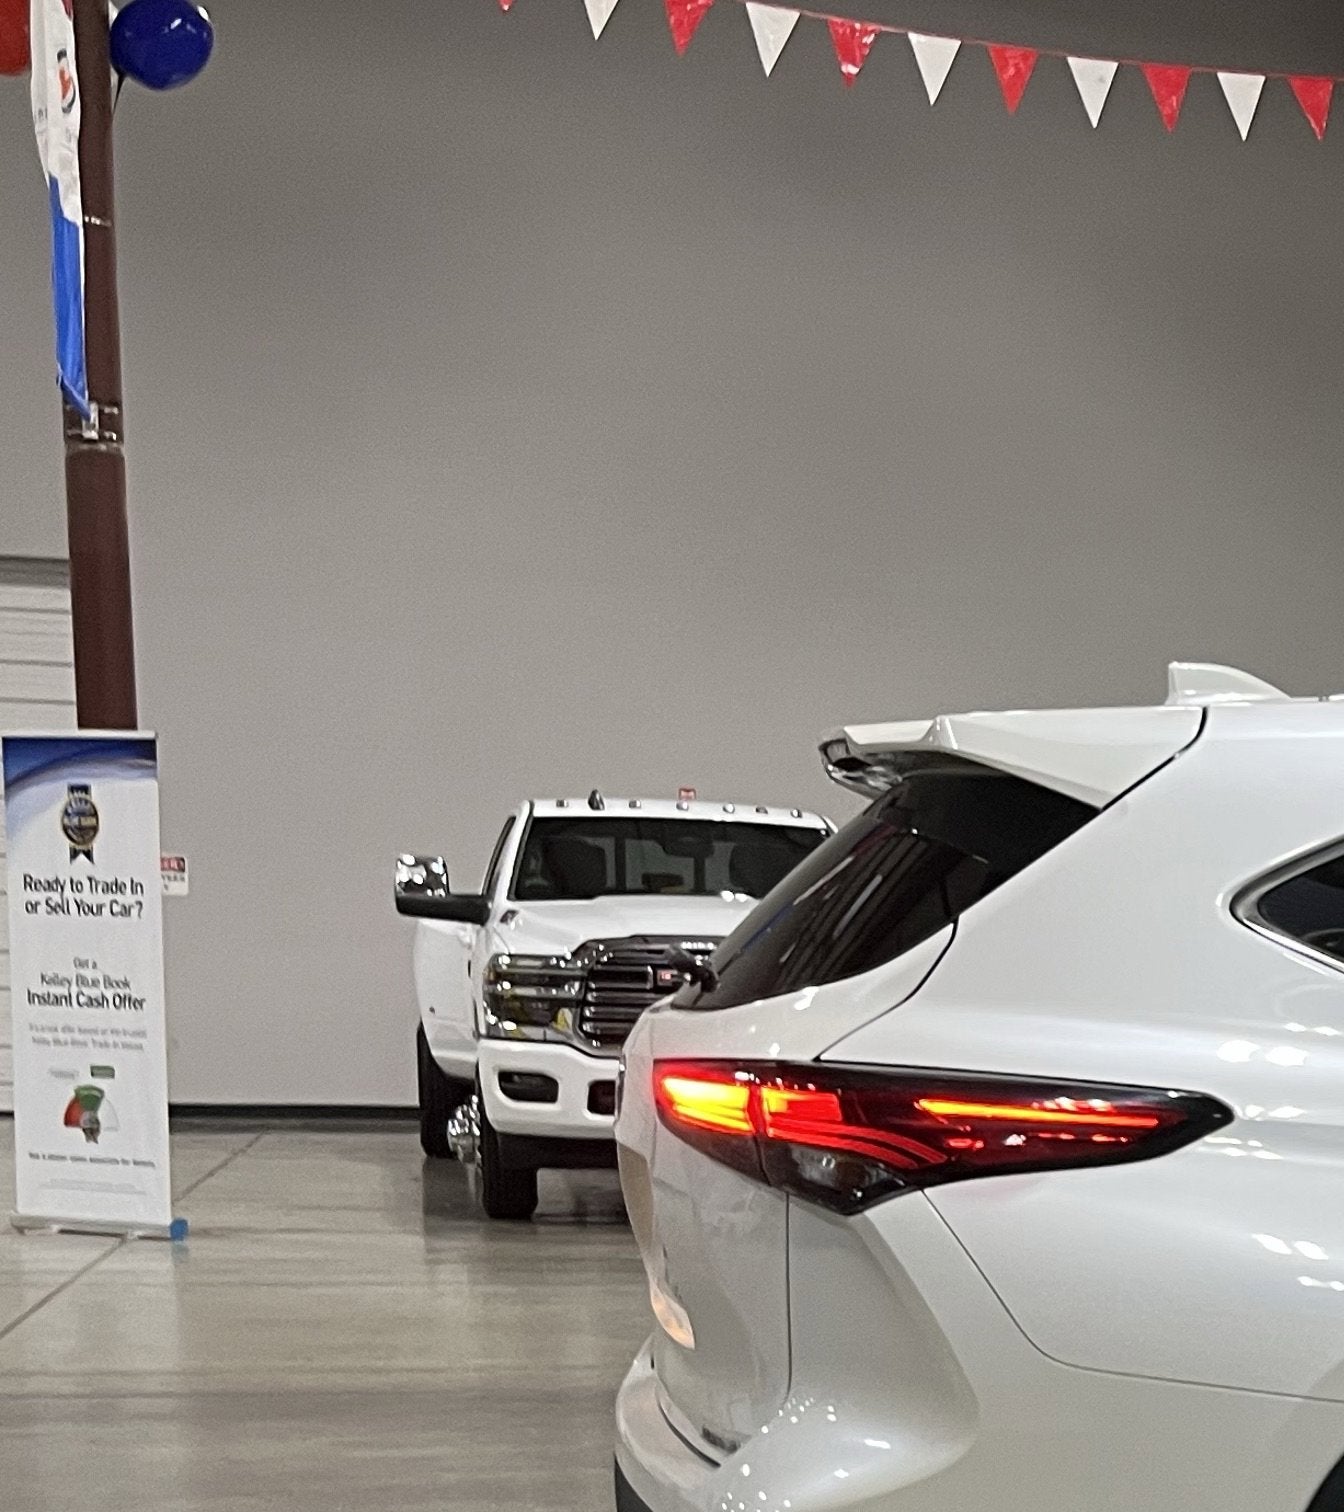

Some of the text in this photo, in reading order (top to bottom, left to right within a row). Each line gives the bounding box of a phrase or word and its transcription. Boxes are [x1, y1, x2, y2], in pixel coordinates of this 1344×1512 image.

[23, 873, 66, 897] Ready
[70, 877, 84, 893] to
[86, 875, 127, 896] Trade
[130, 877, 144, 896] In
[25, 896, 143, 918] or Sell Your Car?
[27, 988, 146, 1010] Instant Cash Offer
